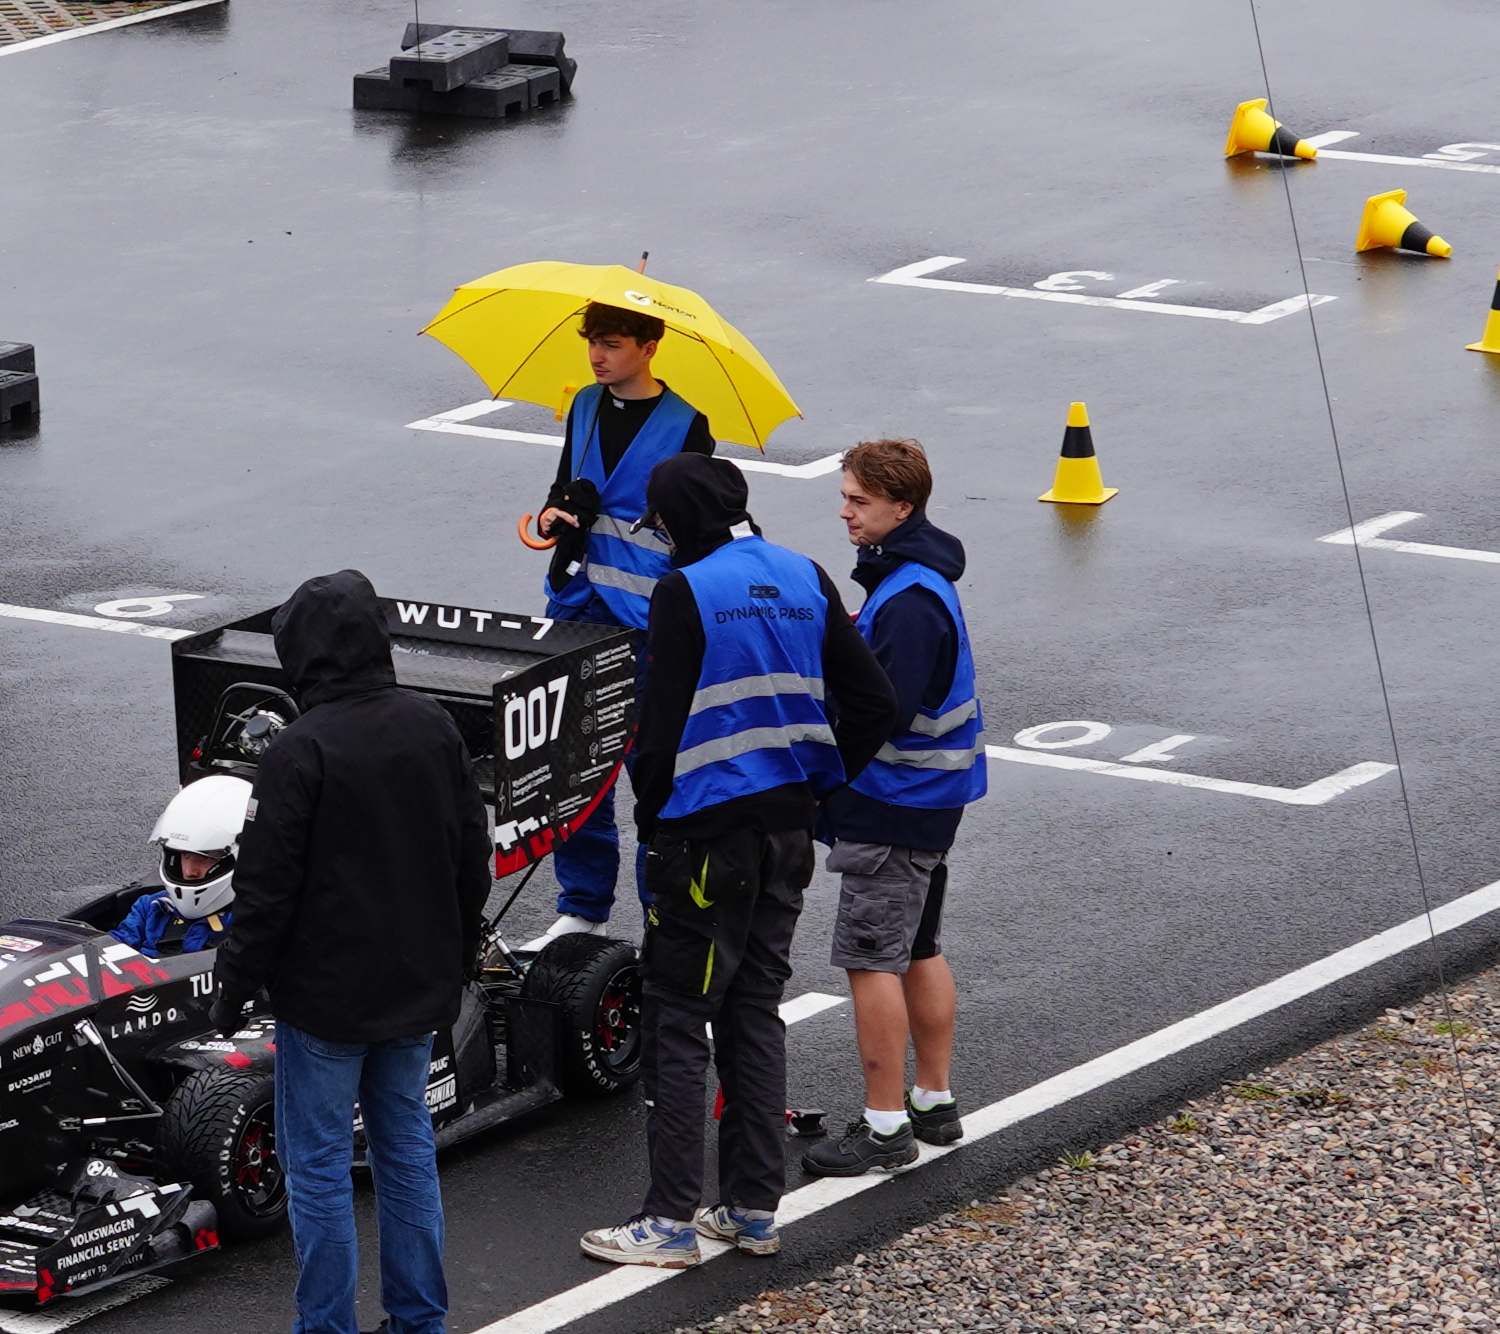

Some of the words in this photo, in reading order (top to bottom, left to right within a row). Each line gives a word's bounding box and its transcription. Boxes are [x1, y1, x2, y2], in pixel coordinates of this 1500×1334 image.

[396, 601, 554, 640] WUT-7
[778, 608, 814, 622] PASS
[190, 971, 213, 997] TU
[12, 1044, 31, 1060] NEW
[44, 1030, 63, 1047] CUT
[70, 1218, 135, 1248] VOLKSWAGEN
[57, 1246, 105, 1270] FINANCIAL
